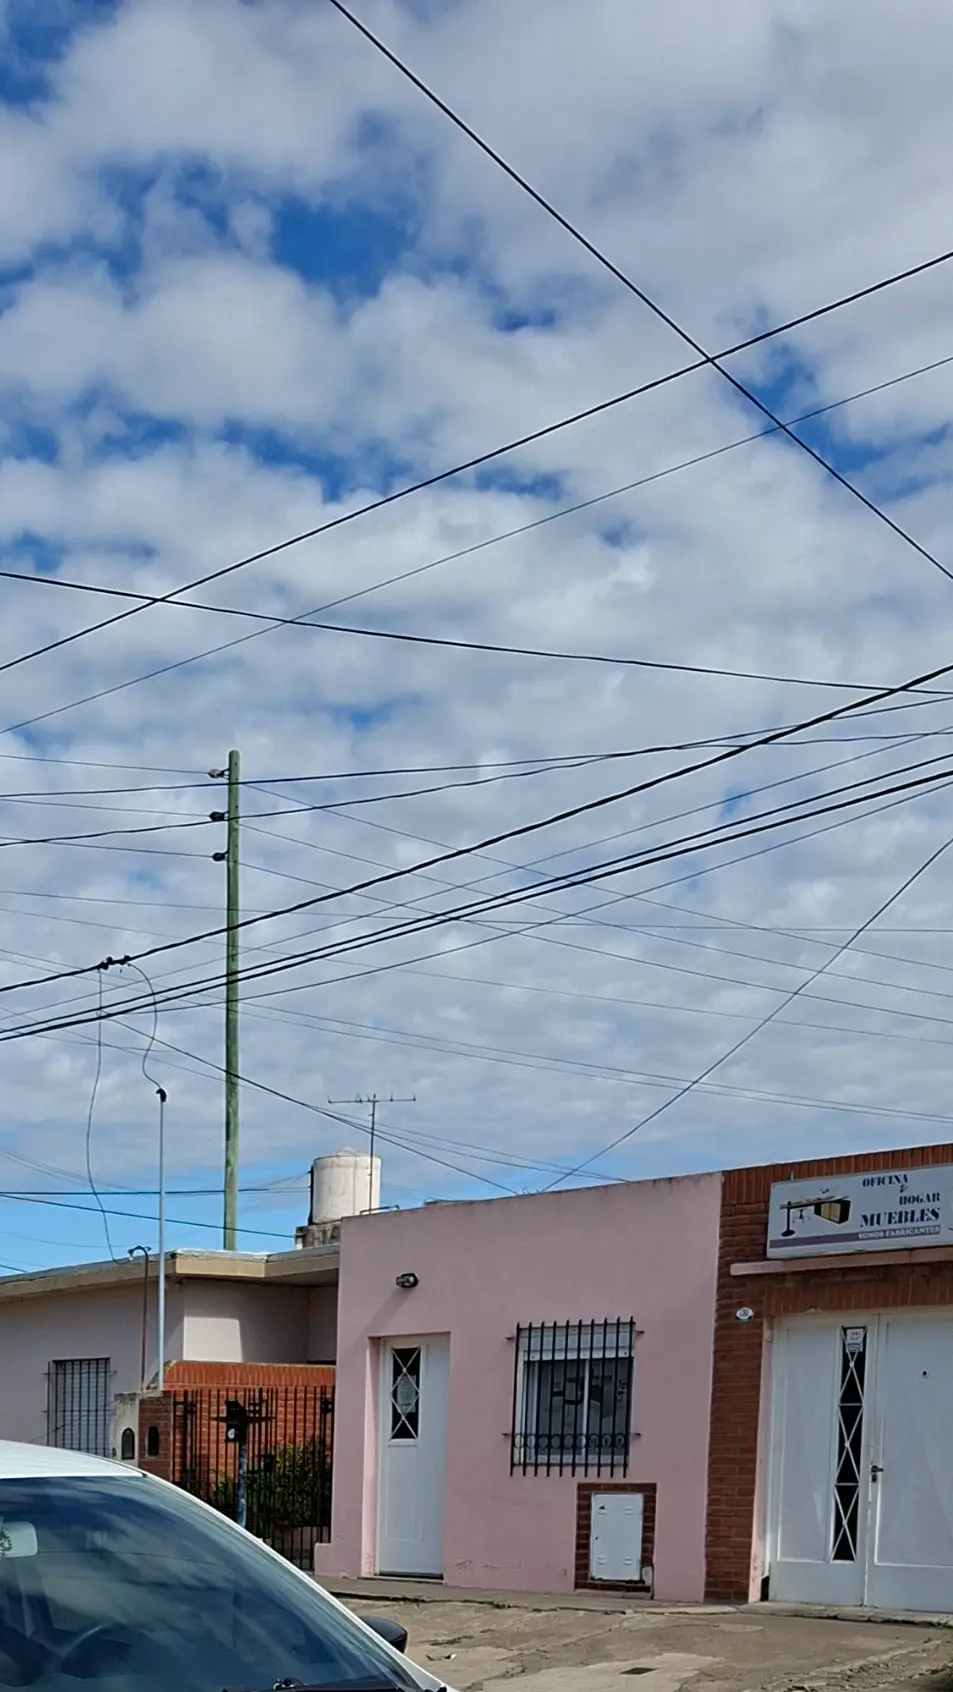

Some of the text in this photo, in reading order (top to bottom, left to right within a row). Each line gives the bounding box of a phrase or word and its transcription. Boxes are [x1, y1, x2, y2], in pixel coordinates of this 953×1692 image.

[862, 1174, 908, 1187] OFICINA
[899, 1192, 940, 1206] HOGAR
[860, 1208, 940, 1228] MUEBLES
[885, 1226, 939, 1237] FABRICANTES
